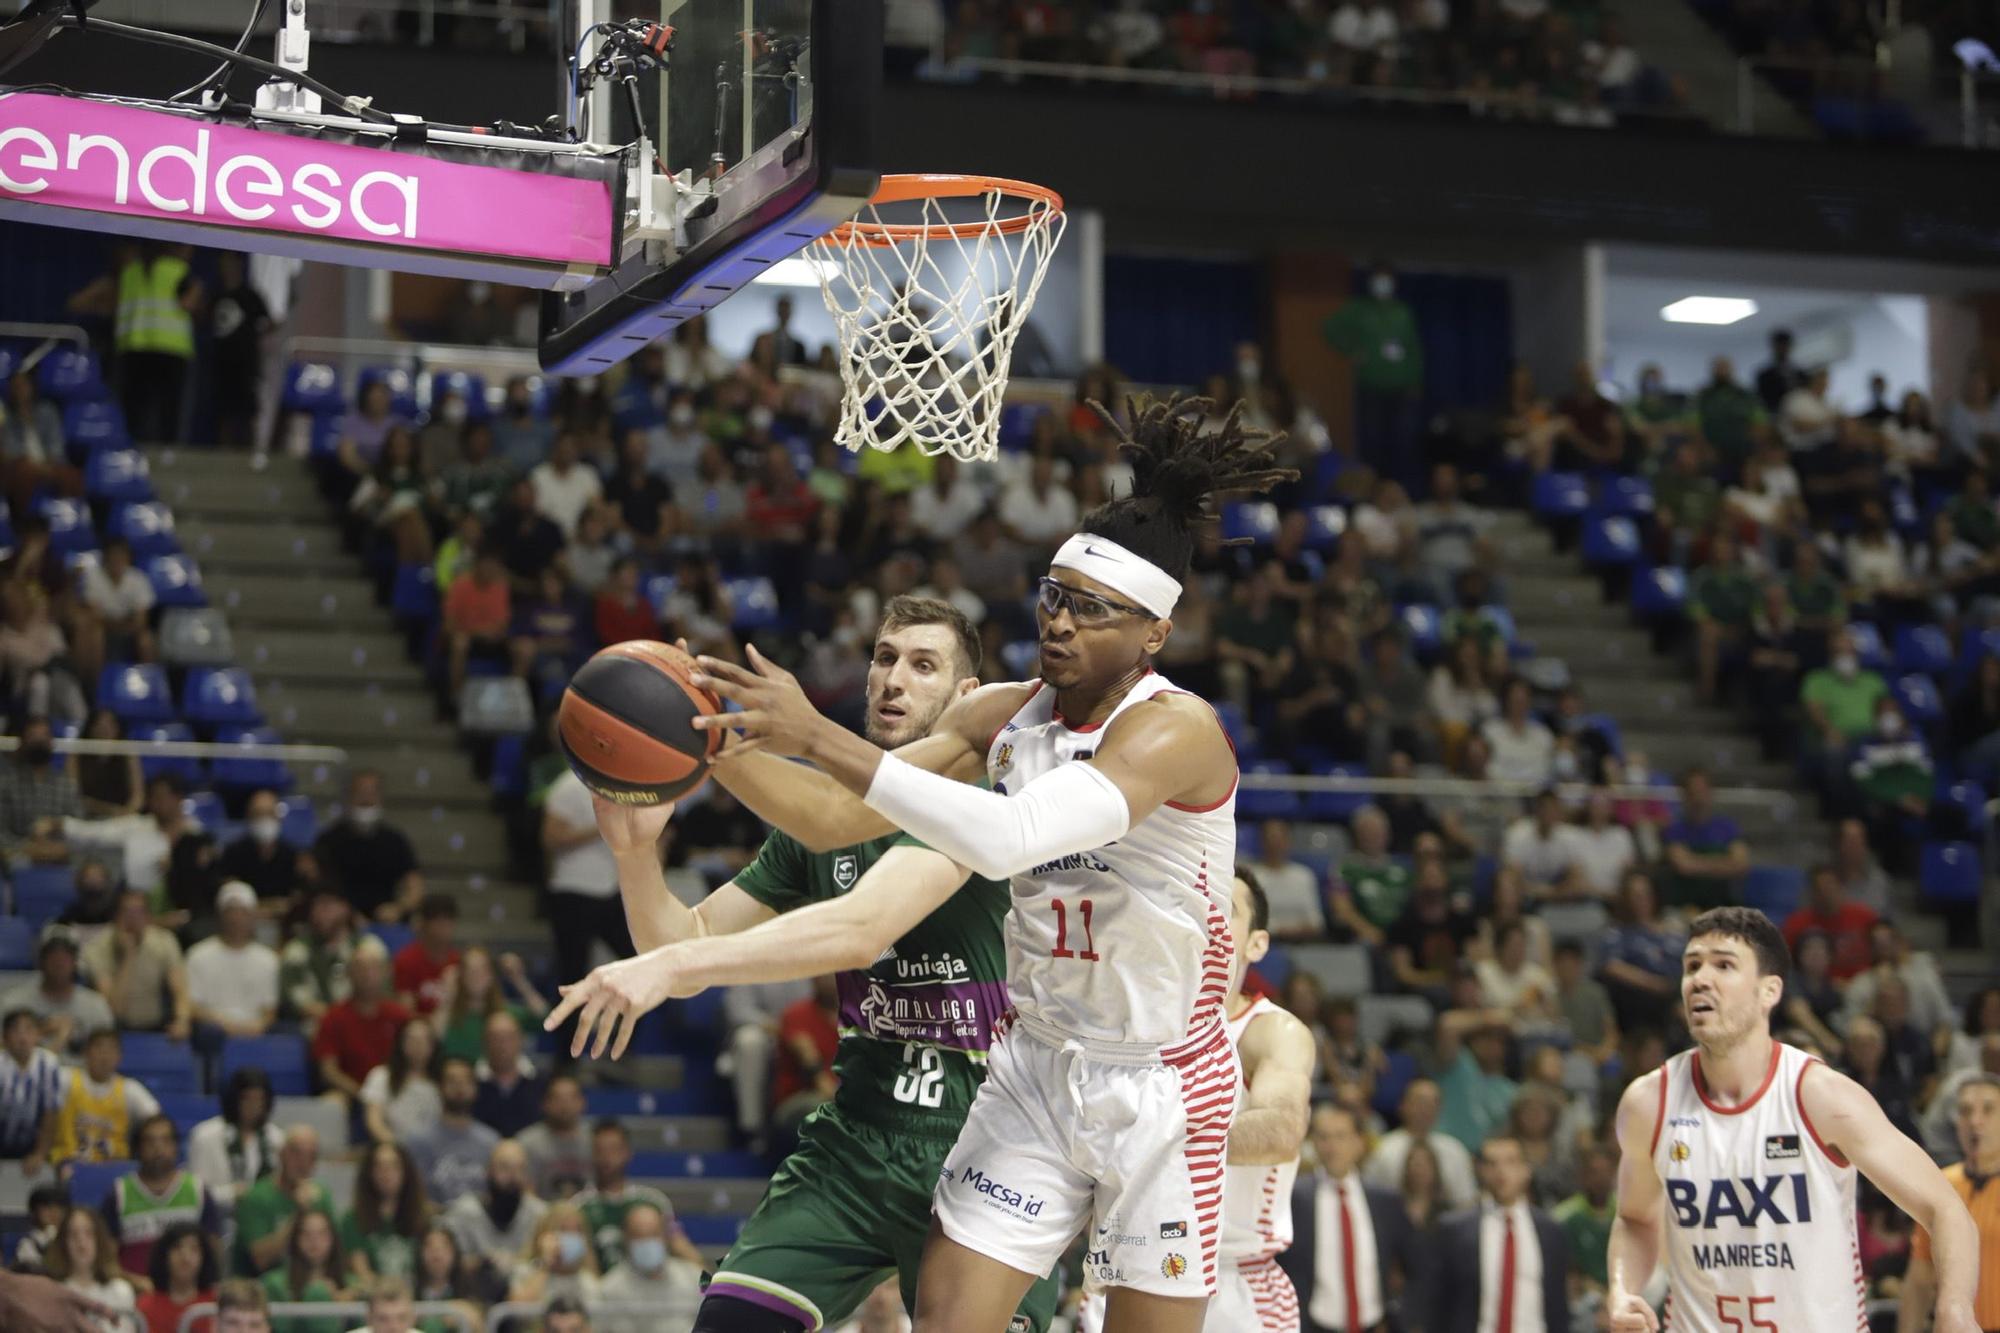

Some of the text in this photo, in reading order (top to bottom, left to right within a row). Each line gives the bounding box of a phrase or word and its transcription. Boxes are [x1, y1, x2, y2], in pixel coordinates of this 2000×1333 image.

[0, 127, 419, 239] endesa
[1051, 898, 1100, 962] 11
[893, 1041, 945, 1108] 32
[961, 1165, 1022, 1208] Macsa
[1024, 1194, 1044, 1217] id
[1666, 1173, 1812, 1229] BAXI
[1162, 1229, 1182, 1238] acb
[1693, 1242, 1796, 1271] MANRESA
[1716, 1295, 1777, 1333] 55
